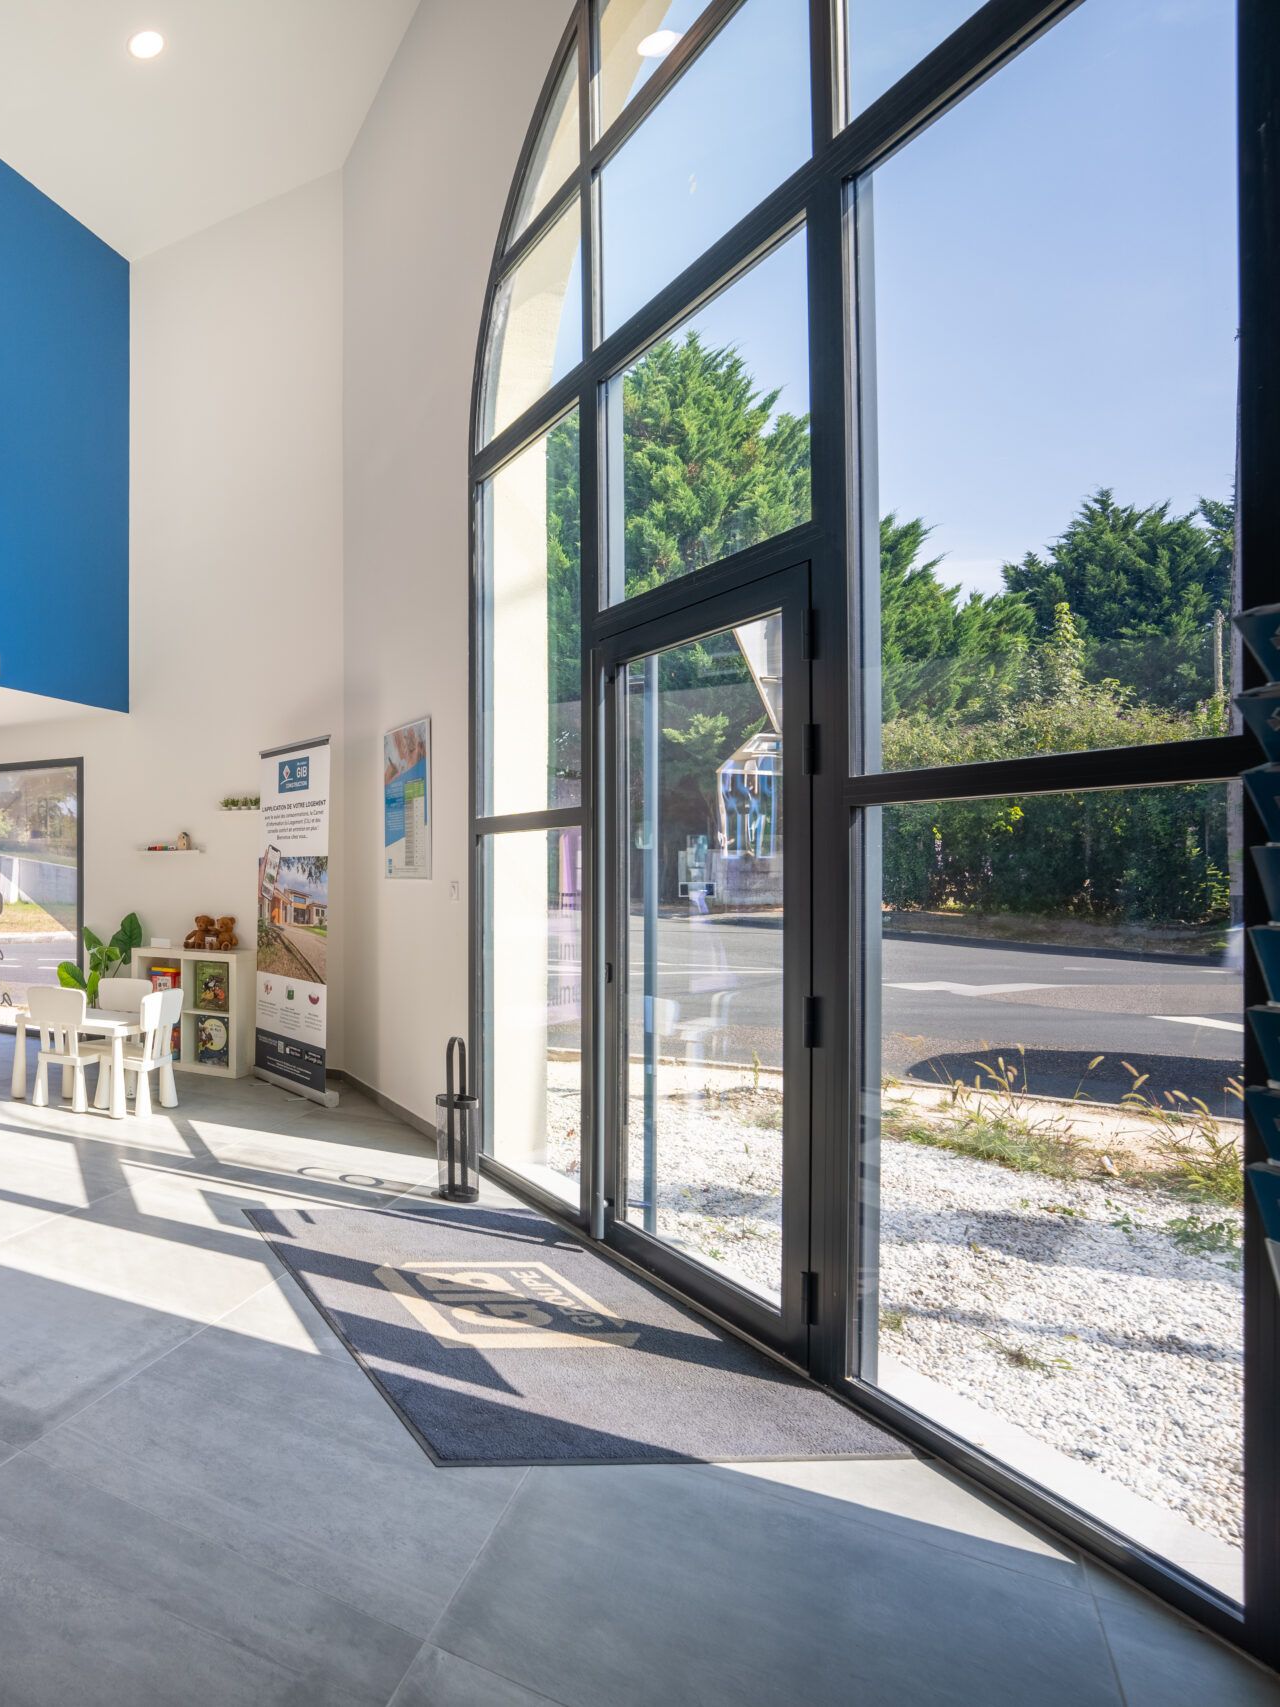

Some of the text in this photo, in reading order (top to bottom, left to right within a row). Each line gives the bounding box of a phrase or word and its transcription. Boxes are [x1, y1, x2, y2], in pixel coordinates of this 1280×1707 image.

[296, 766, 308, 778] GIB
[416, 1271, 554, 1328] GIB
[509, 1269, 605, 1328] GROUPE
